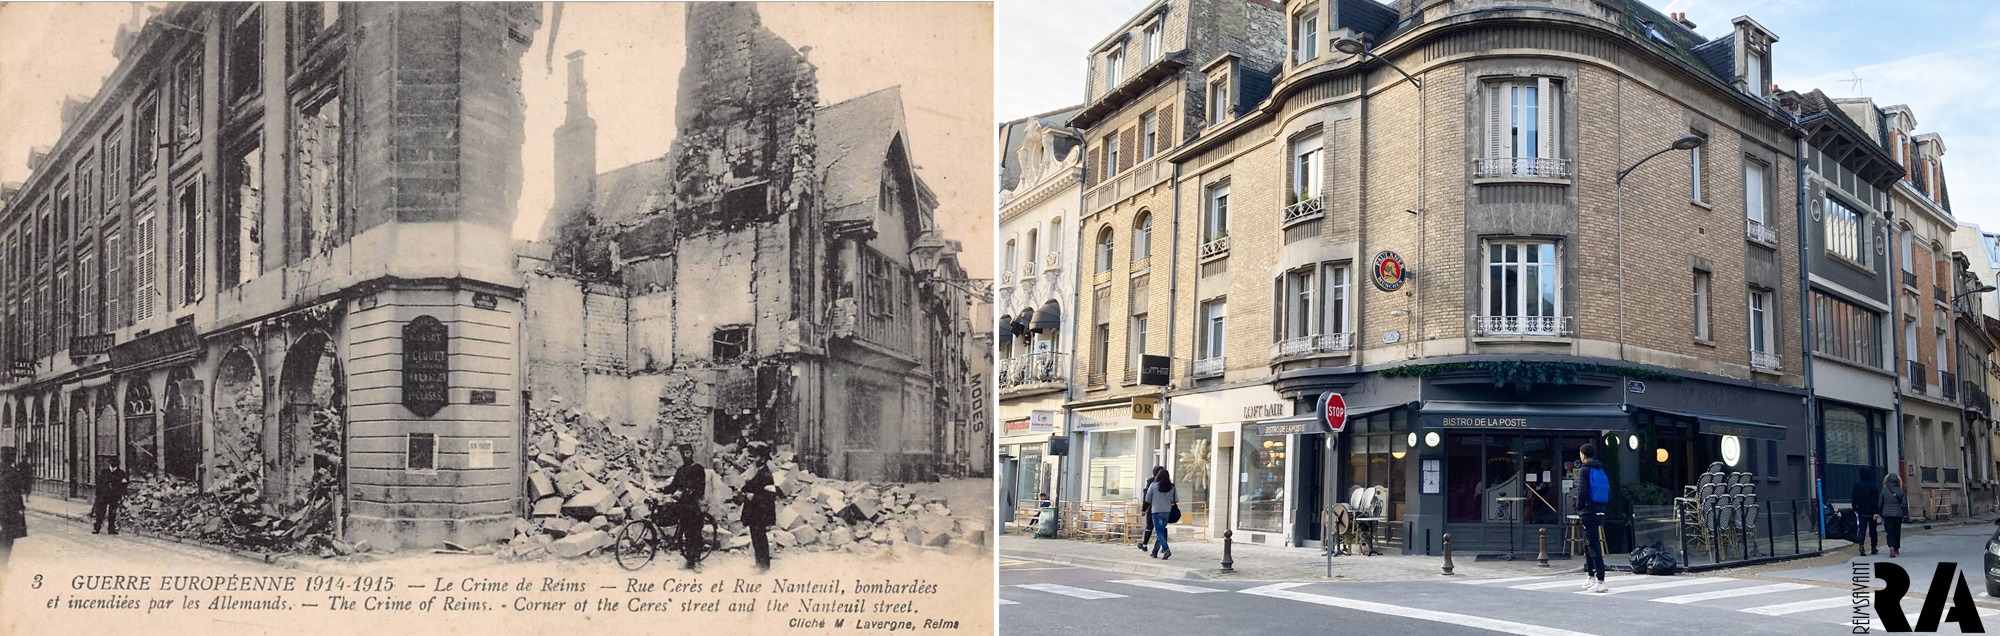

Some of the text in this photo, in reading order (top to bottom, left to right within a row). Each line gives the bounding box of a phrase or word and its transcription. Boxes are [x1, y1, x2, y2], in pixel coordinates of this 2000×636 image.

[1375, 252, 1404, 270] PAULANER
[971, 374, 984, 433] MODES
[1133, 403, 1152, 414] OR
[1328, 405, 1344, 417] STOP
[1443, 417, 1527, 427] BISTRO DE LA POSTE
[1265, 425, 1280, 434] BISTRO
[1291, 423, 1306, 433] POSTE
